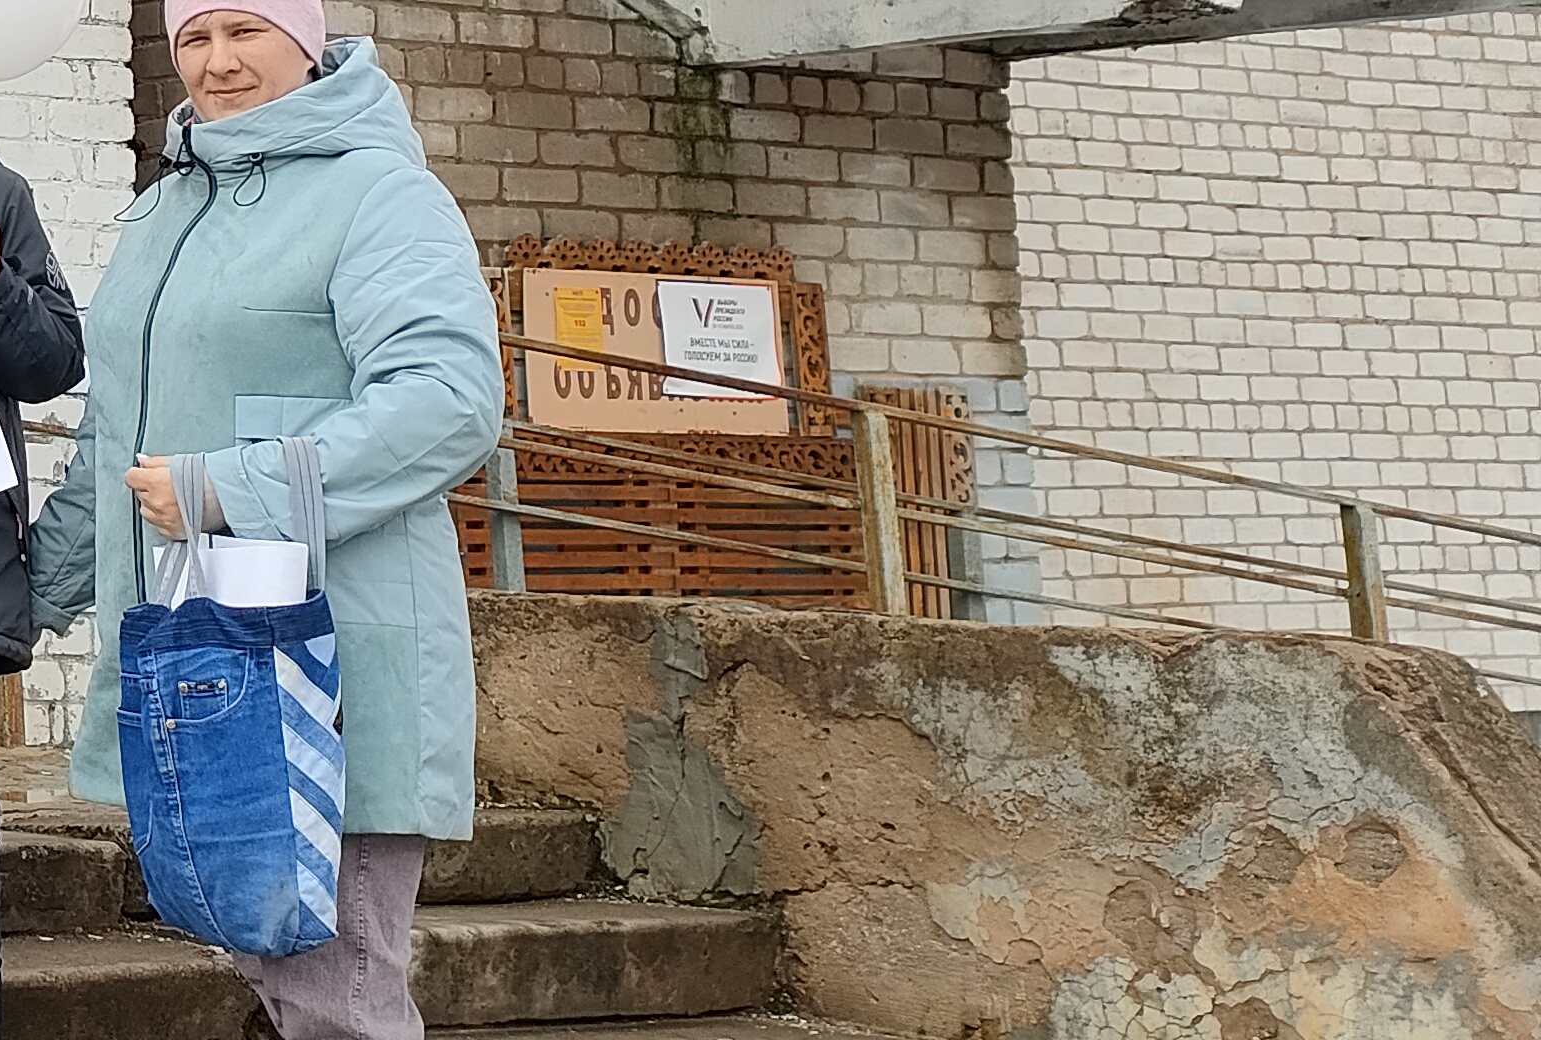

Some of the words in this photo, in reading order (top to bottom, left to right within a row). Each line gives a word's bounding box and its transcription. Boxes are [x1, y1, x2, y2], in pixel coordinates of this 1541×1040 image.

[690, 338, 717, 348] ВМЕСТЕ
[717, 339, 731, 348] МЫ
[731, 340, 749, 349] СИЛА
[684, 351, 721, 362] ГОЛОСУЕМ
[723, 352, 732, 362] ЗА
